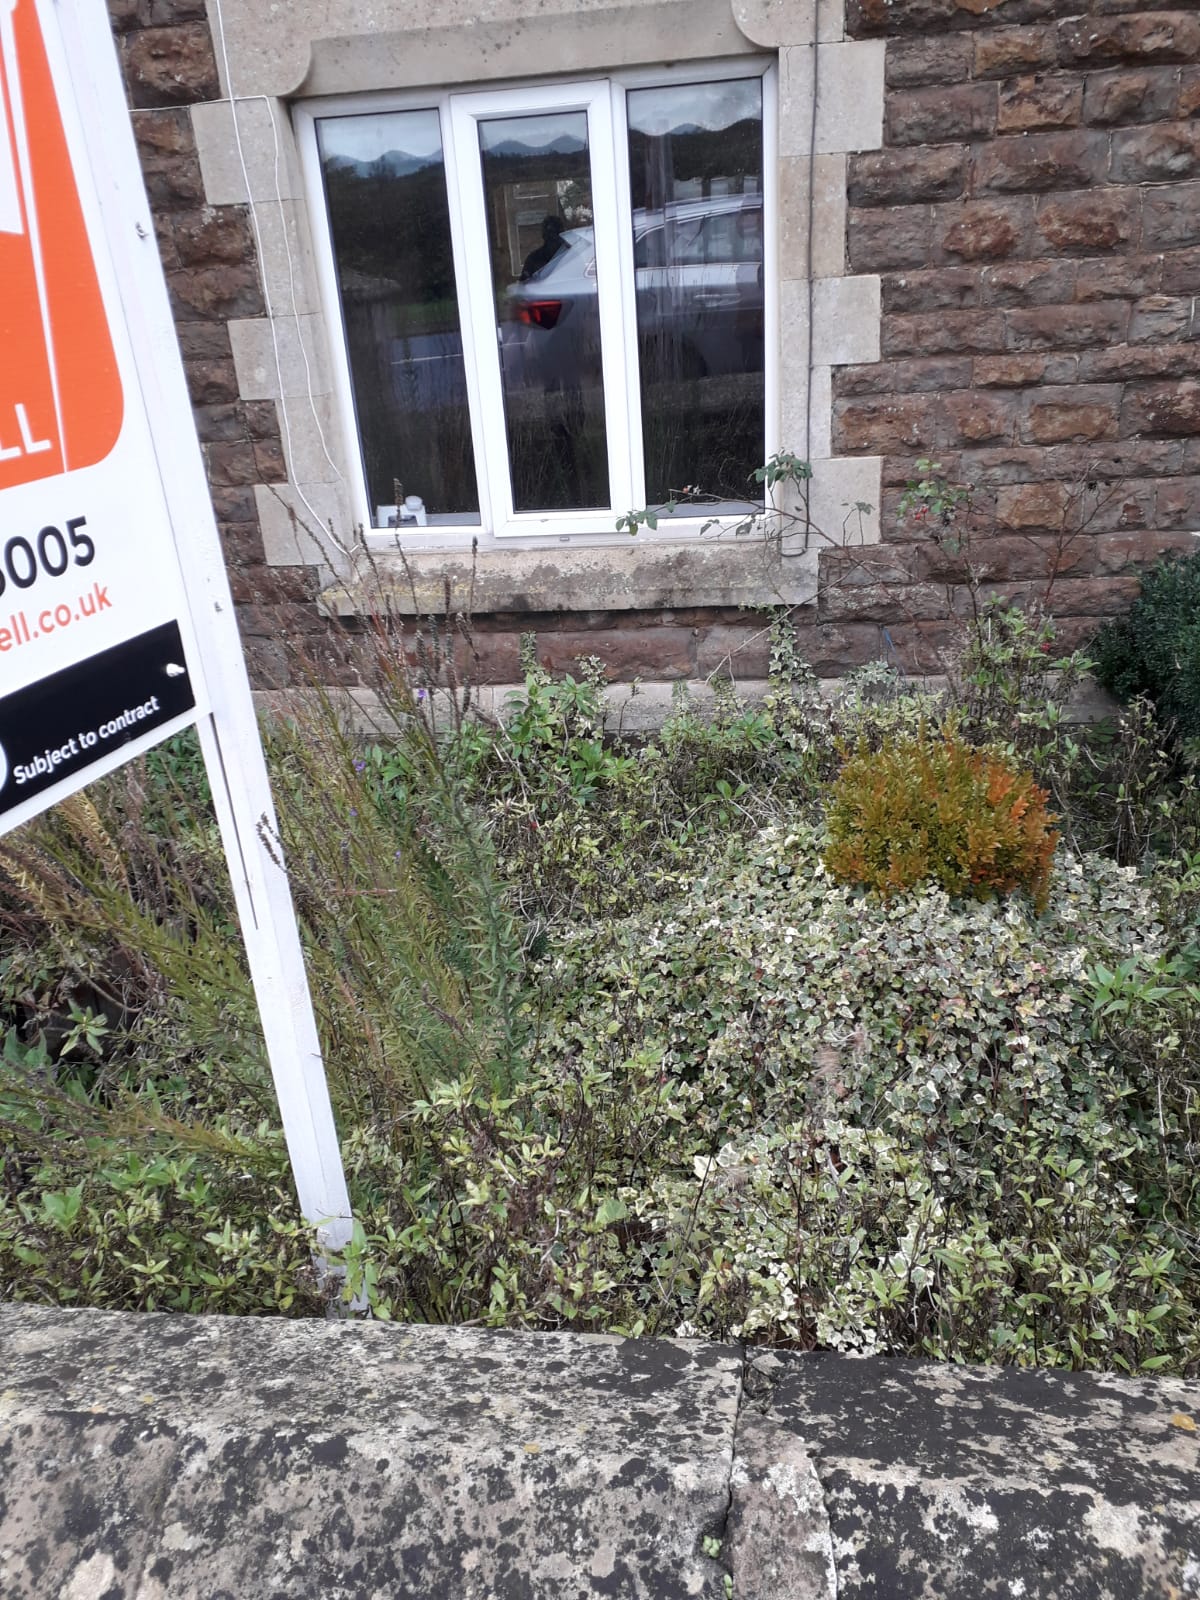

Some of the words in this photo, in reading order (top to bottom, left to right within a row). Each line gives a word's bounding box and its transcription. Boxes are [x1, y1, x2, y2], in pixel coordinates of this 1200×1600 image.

[0, 515, 95, 598] 005
[0, 582, 112, 652] ell.co.uk
[13, 738, 79, 784] Subject
[78, 731, 98, 749] to
[98, 695, 160, 739] contract
